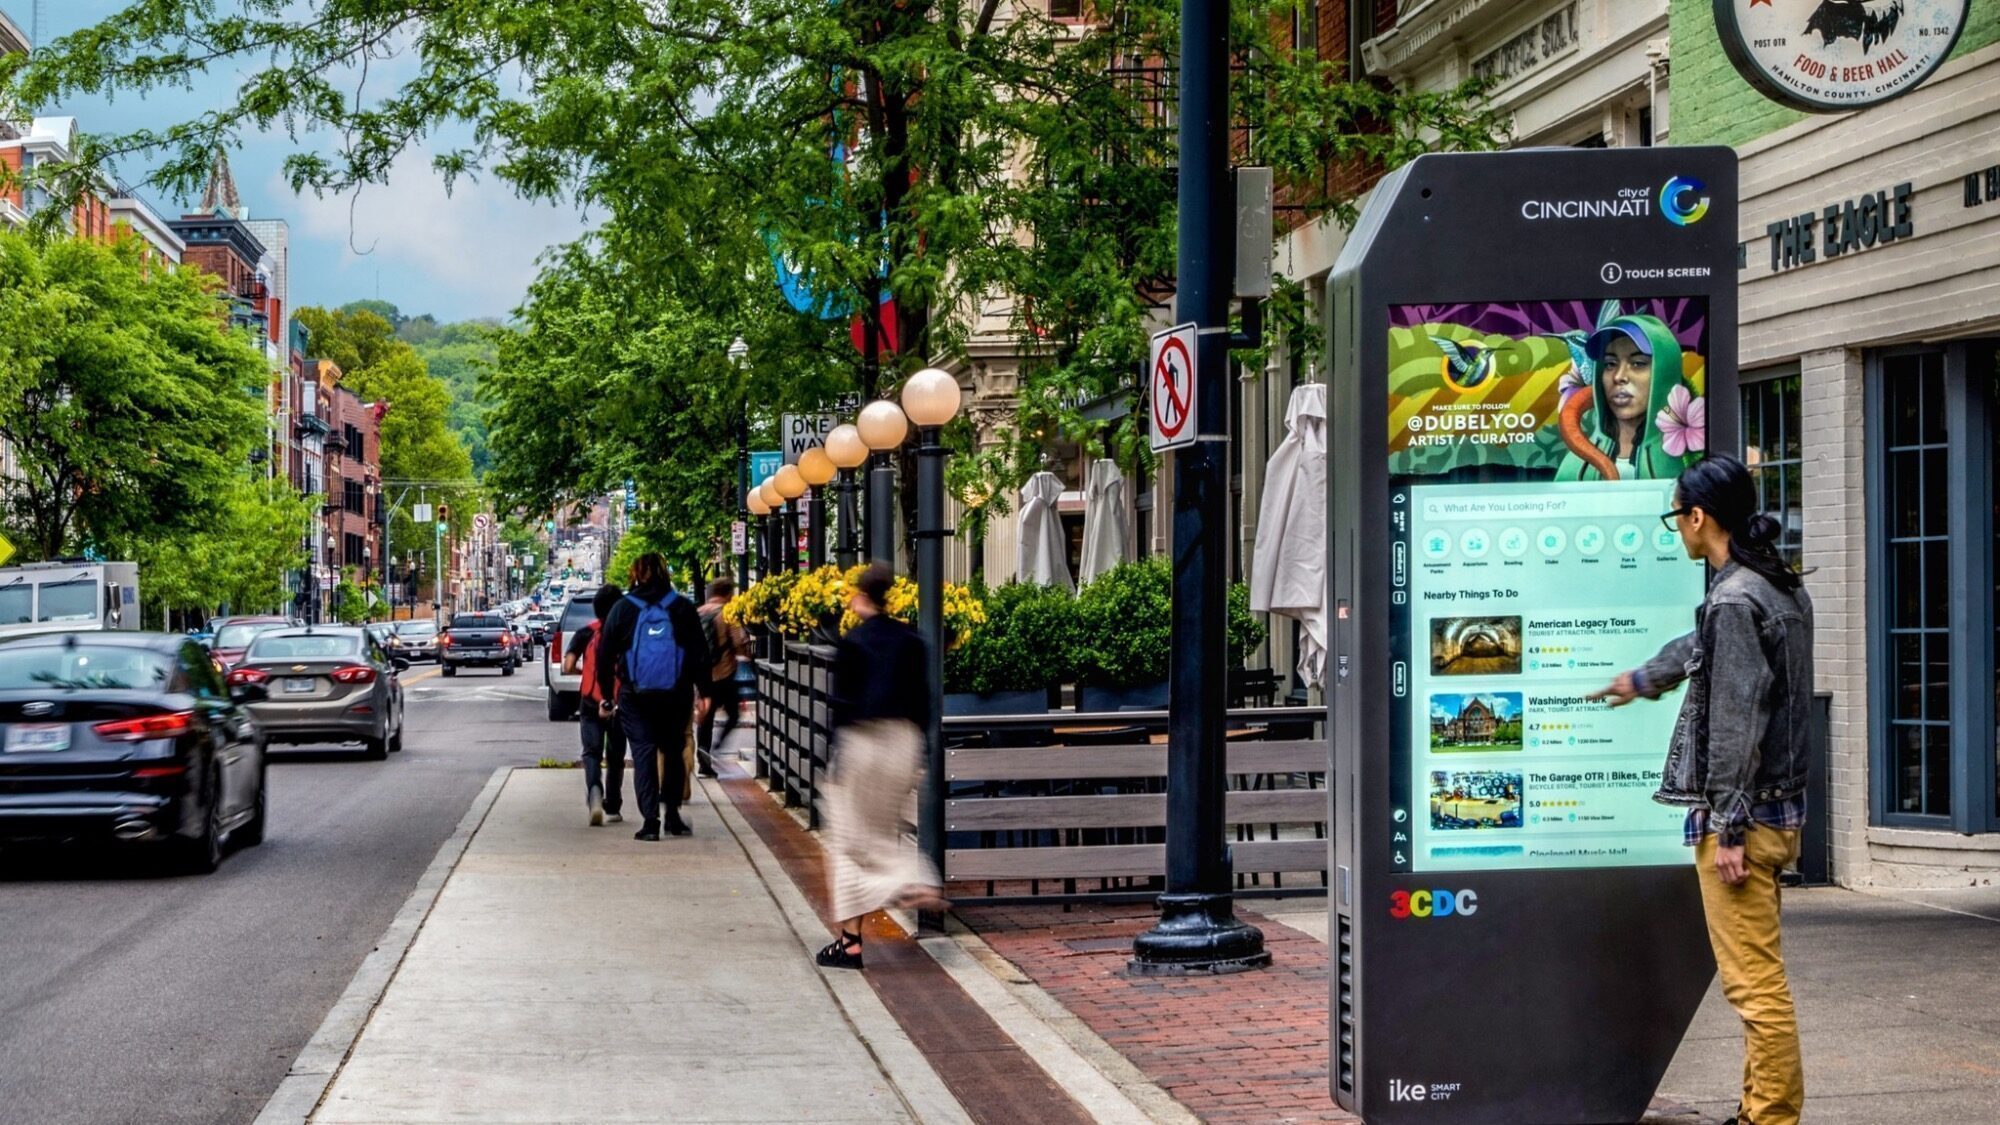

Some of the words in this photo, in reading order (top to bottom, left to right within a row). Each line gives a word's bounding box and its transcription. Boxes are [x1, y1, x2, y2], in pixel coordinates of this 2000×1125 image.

[1919, 28, 1931, 36] NO.
[1934, 27, 1950, 36] 1342
[1754, 39, 1771, 48] POST
[1773, 38, 1786, 46] OTR
[1793, 54, 1826, 79] FOOD
[1830, 67, 1838, 82] &
[1843, 66, 1875, 82] BEER
[1878, 48, 1909, 74] HALL
[1771, 64, 1820, 95] HAMILTON
[1824, 90, 1871, 99] COUNTY,
[1876, 55, 1931, 94] CINCINNATI
[1618, 188, 1638, 198] city
[1638, 187, 1650, 196] of
[1522, 199, 1650, 220] CINCINNATI
[1767, 212, 1816, 272] THE
[1823, 182, 1913, 258] EAGLE
[1625, 268, 1664, 278] TOUCH
[1667, 268, 1710, 278] SCREEN
[792, 418, 830, 434] ONE
[1408, 412, 1536, 432] @DUBELYOO
[1408, 434, 1454, 446] ARTIST
[1458, 434, 1466, 445] /
[1470, 432, 1536, 444] CURATOR
[1444, 504, 1468, 512] What
[1470, 504, 1486, 512] Are
[1488, 502, 1506, 512] You
[1508, 502, 1544, 512] Looking
[1547, 501, 1566, 510] For?
[1424, 591, 1456, 601] Nearby
[1459, 590, 1490, 600] Things
[1492, 590, 1504, 598] To
[1506, 589, 1518, 598] Do
[1528, 620, 1572, 629] American
[1574, 618, 1608, 629] Legacy
[1610, 618, 1636, 627] Tours
[1528, 696, 1583, 706] Washington
[1586, 696, 1606, 704] Park
[1529, 774, 1546, 782] The
[1550, 773, 1582, 784] Garage
[1584, 772, 1604, 781] OTR
[1612, 772, 1640, 781] Bikes,
[1390, 889, 1478, 918] 3CDC
[1389, 1079, 1426, 1102] ike
[1430, 1084, 1461, 1092] SMART
[1430, 1092, 1451, 1100] CITY
